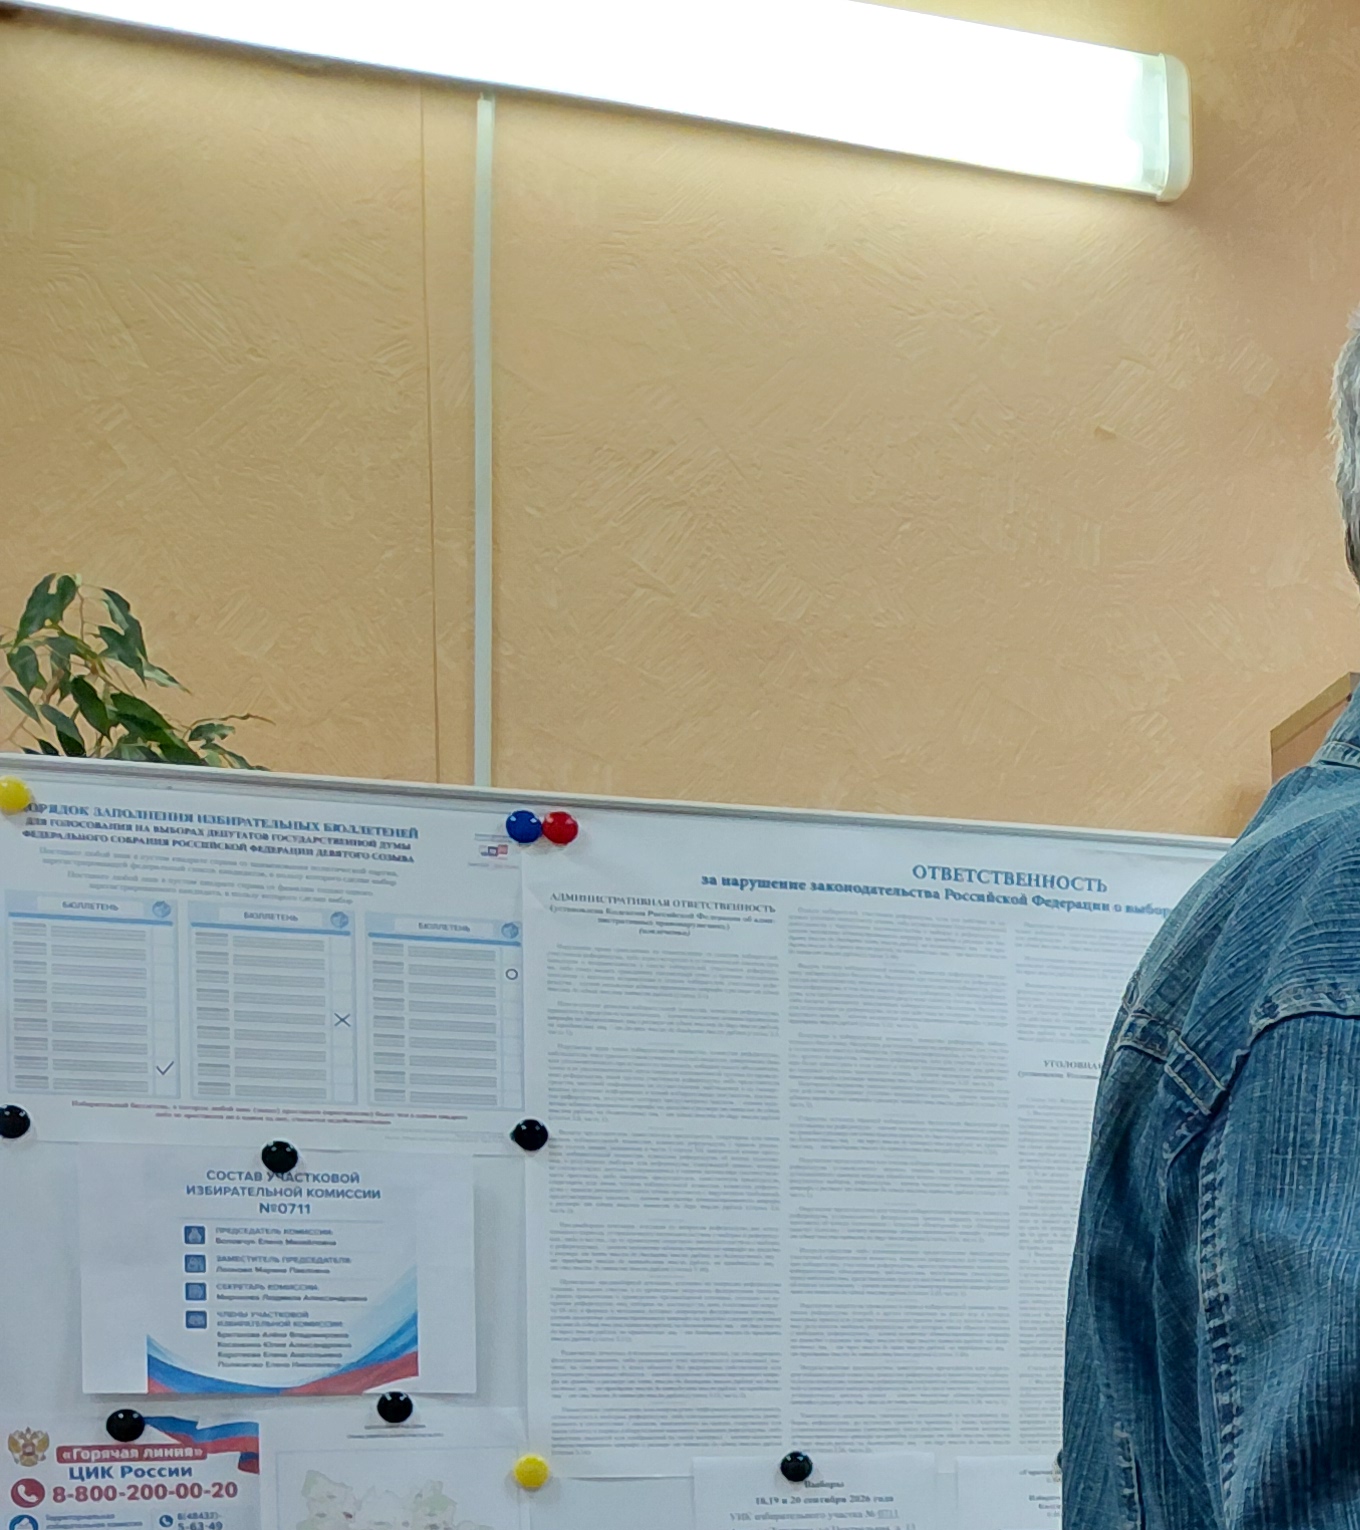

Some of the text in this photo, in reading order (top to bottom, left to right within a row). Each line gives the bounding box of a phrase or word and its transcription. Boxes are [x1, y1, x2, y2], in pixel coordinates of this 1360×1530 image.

[24, 802, 419, 839] ОРЯДОК ЗАПОЛНЕНИЯ ИЗБИРАТЕЛЬНЫХ БЮЛЛЕТЕНЕЙ
[25, 817, 411, 851] ДЛЯ ГОЛОСОВАНИЯ НА ВЫБОРАХ ДЕПУТАТОВ ГОСУДАРСТВЕННОЙ ДУМЫ
[22, 829, 415, 864] ФЕДЕРАЛЬНОГО СОБРАНИЯ РОССИЙСКОЙ ФЕДЕРАЦИИ ДЕВЯТОГО СОЗЫВА
[913, 864, 1108, 893] ОТВЕТСТВЕННОСТЬ
[61, 900, 119, 912] БЮЛЛЕТЕНЬ
[551, 892, 776, 913] АДМИНИСТРАТИВНАЯ ОТВЕТСТВЕННОСТЬ
[701, 874, 1172, 919] за нарушение законодательства Российской Федерации о выбор
[206, 1170, 360, 1184] СОСТАВ УЧАСТКОВОЙ
[186, 1185, 381, 1200] ИЗБИРАТЕЛЬНОЙ КОМИССИИ
[216, 1227, 281, 1236] ПРЕДСЕДАТЕЛЬ
[62, 1446, 204, 1463] «Горячая линия»
[68, 1465, 193, 1482] ЦИК России
[52, 1482, 238, 1503] 8-800-200-00-20
